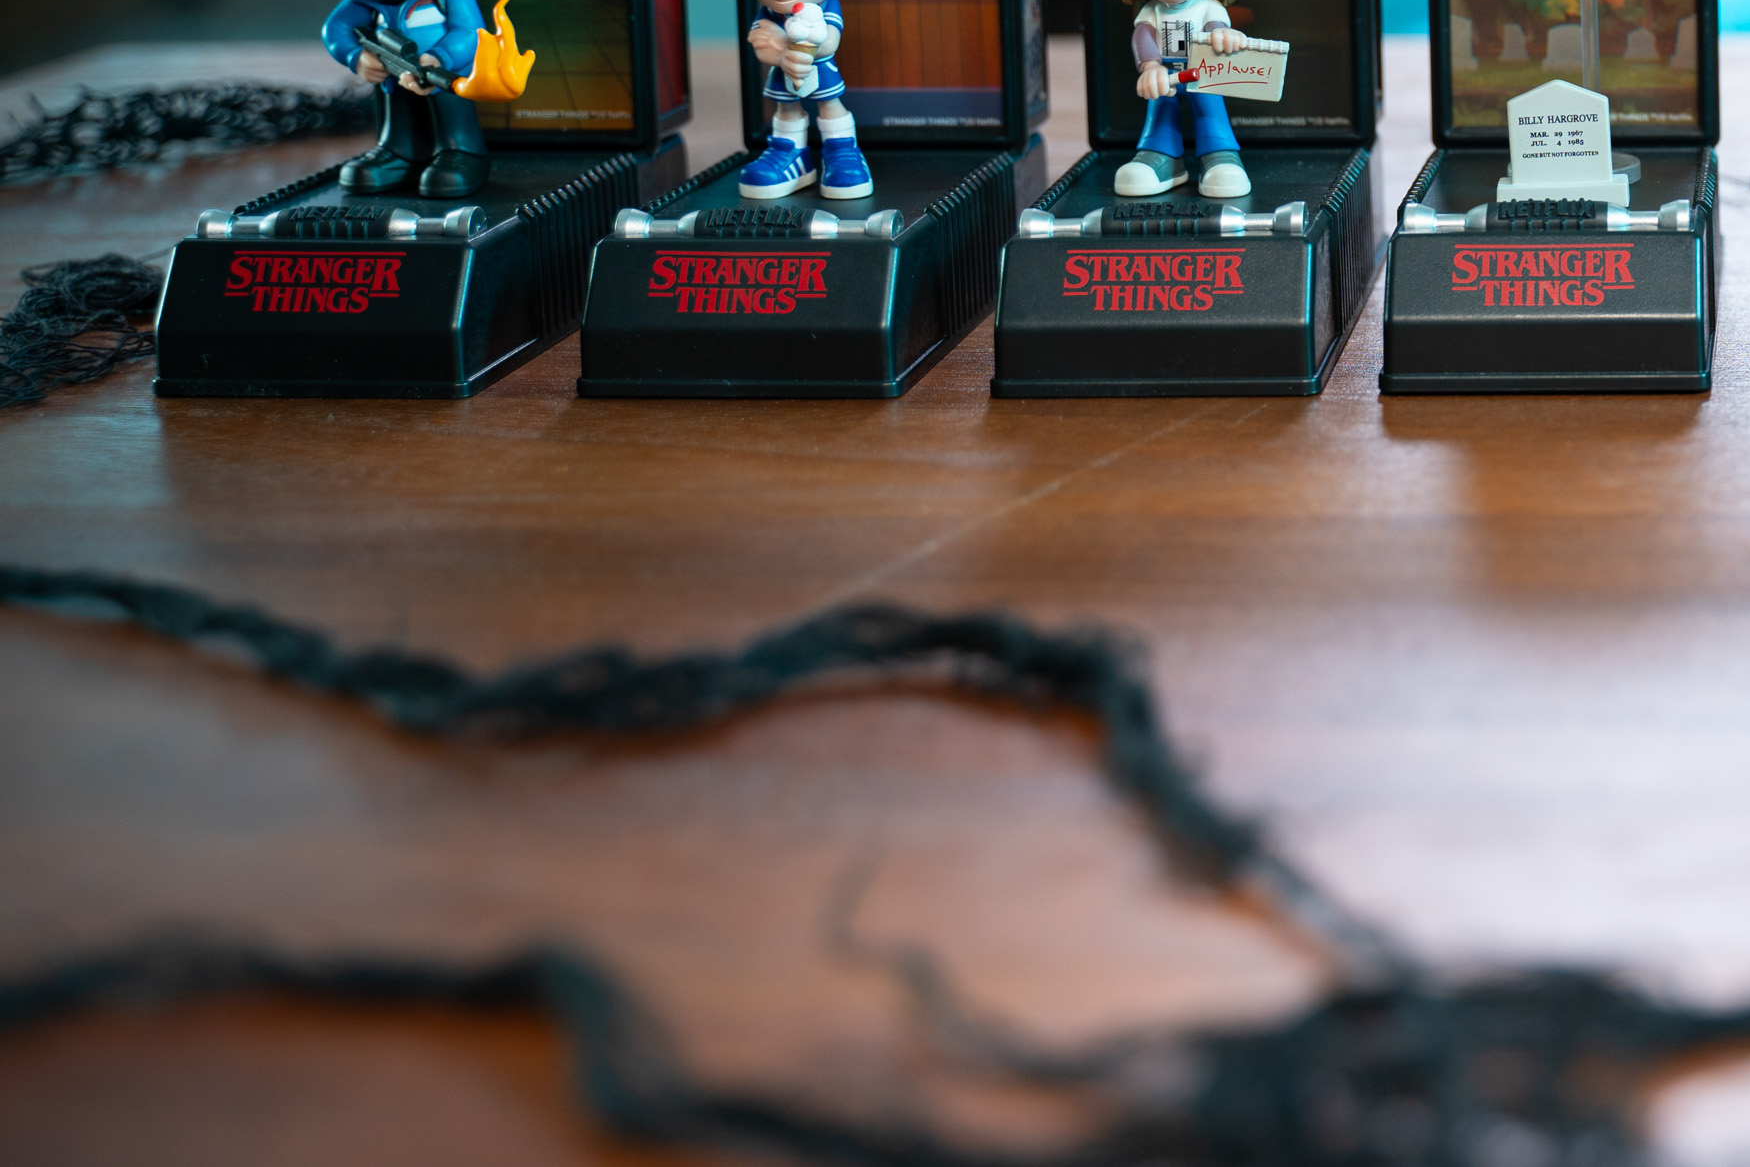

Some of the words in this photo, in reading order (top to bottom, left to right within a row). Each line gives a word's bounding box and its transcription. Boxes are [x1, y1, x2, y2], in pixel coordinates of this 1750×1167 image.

[1518, 115, 1545, 126] BILLY
[1547, 113, 1599, 124] HARGROVE
[1567, 129, 1584, 137] 1967
[1530, 139, 1548, 147] JUL.
[1556, 139, 1562, 147] 4
[1567, 138, 1584, 146] 1985
[1539, 151, 1551, 159] BUT
[1564, 150, 1599, 158] FORGOTTEN
[706, 205, 802, 228] NETFLIX
[1112, 202, 1210, 219] NETFLIX
[1498, 200, 1594, 220] NETFLIX
[226, 256, 402, 291] STRANGER
[649, 256, 828, 292] STRANGER
[1063, 254, 1245, 289] STRANGER
[1452, 249, 1635, 285] STRANGER
[250, 286, 369, 314] THINGS
[675, 287, 797, 315] THINGS
[1090, 284, 1214, 312] THINGS
[1478, 279, 1605, 307] THINGS
